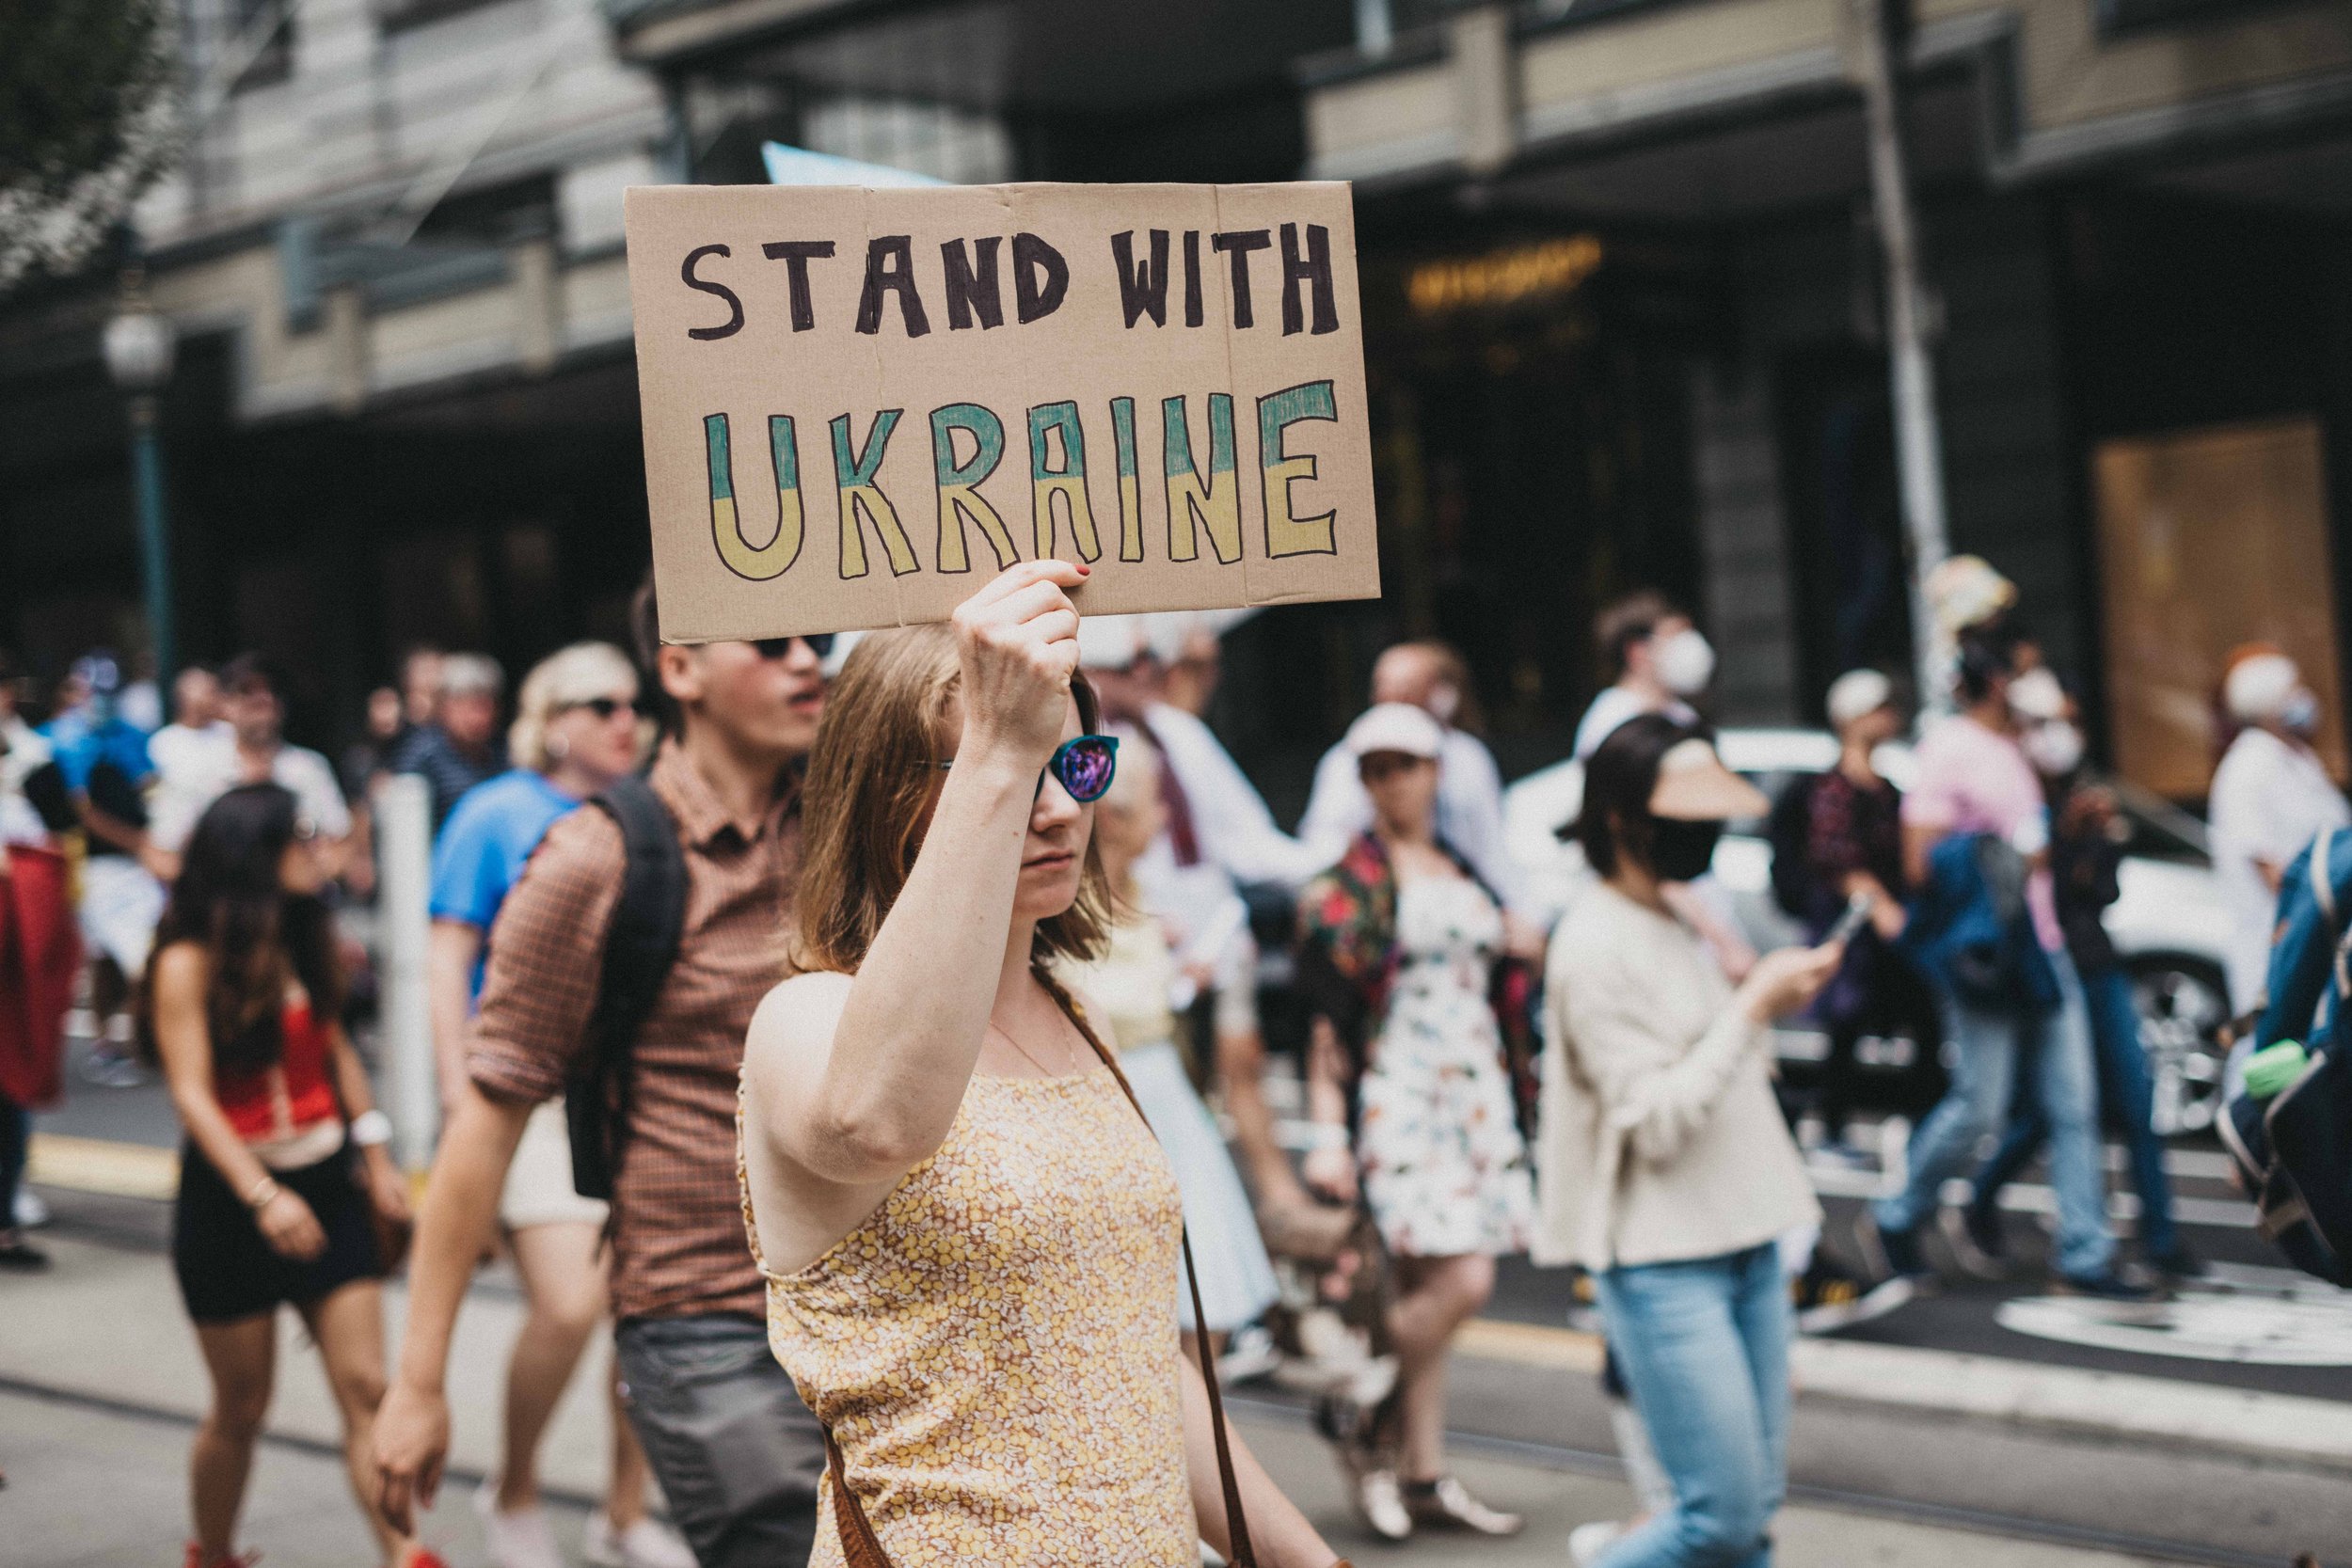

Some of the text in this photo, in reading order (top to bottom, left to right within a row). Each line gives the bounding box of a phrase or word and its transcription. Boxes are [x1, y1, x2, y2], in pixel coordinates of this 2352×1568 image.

[680, 232, 1071, 341] STAND
[1110, 222, 1341, 338] WITH
[703, 379, 1338, 581] UKRAINE
